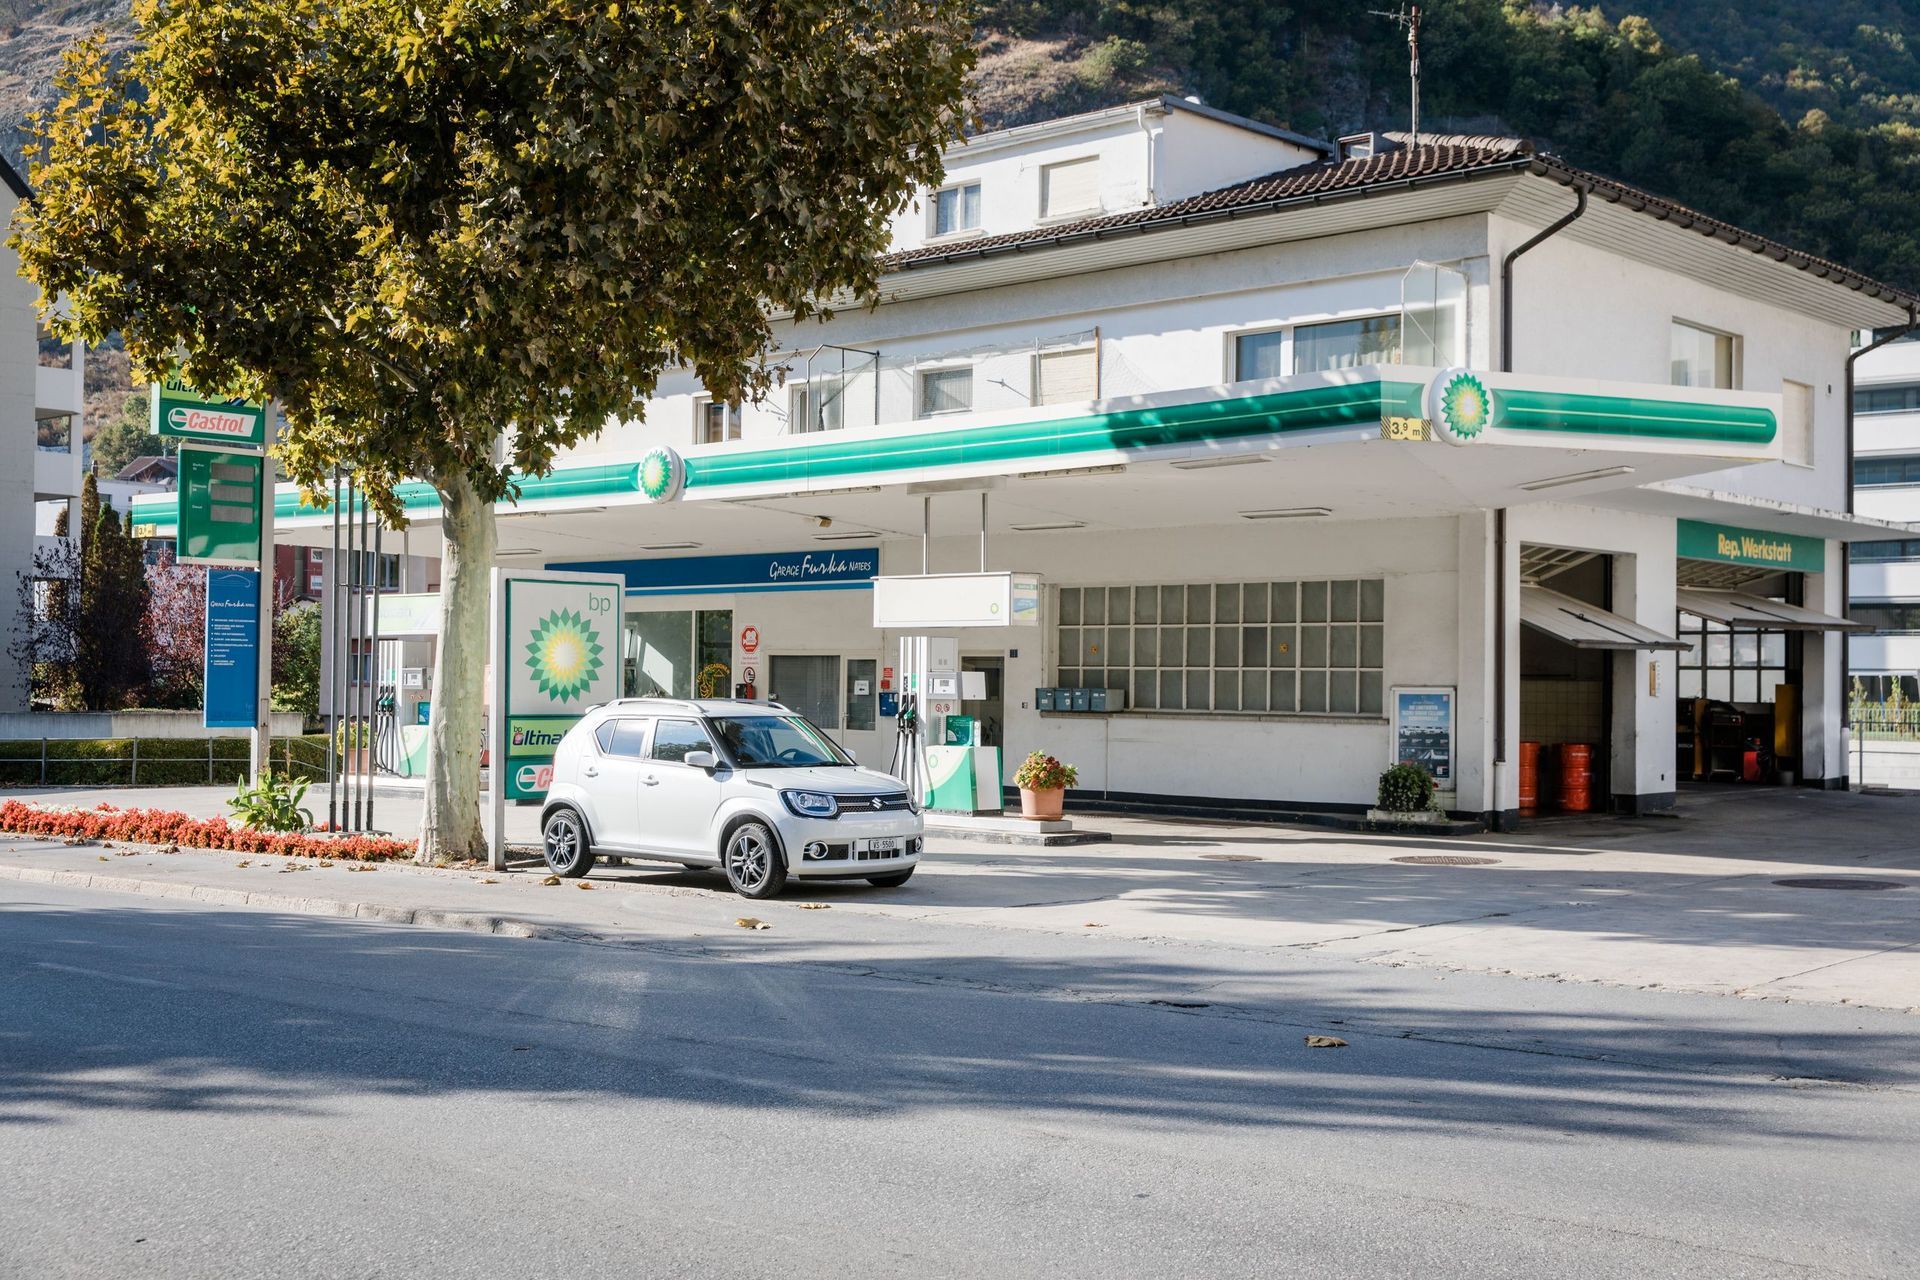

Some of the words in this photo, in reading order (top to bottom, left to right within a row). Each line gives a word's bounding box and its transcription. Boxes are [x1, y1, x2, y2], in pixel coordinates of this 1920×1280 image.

[188, 412, 245, 433] Castrol
[1412, 429, 1421, 437] m
[1718, 533, 1741, 560] Rep.
[1741, 536, 1792, 562] Werkstatt
[800, 553, 848, 578] Furka
[589, 591, 611, 616] bp
